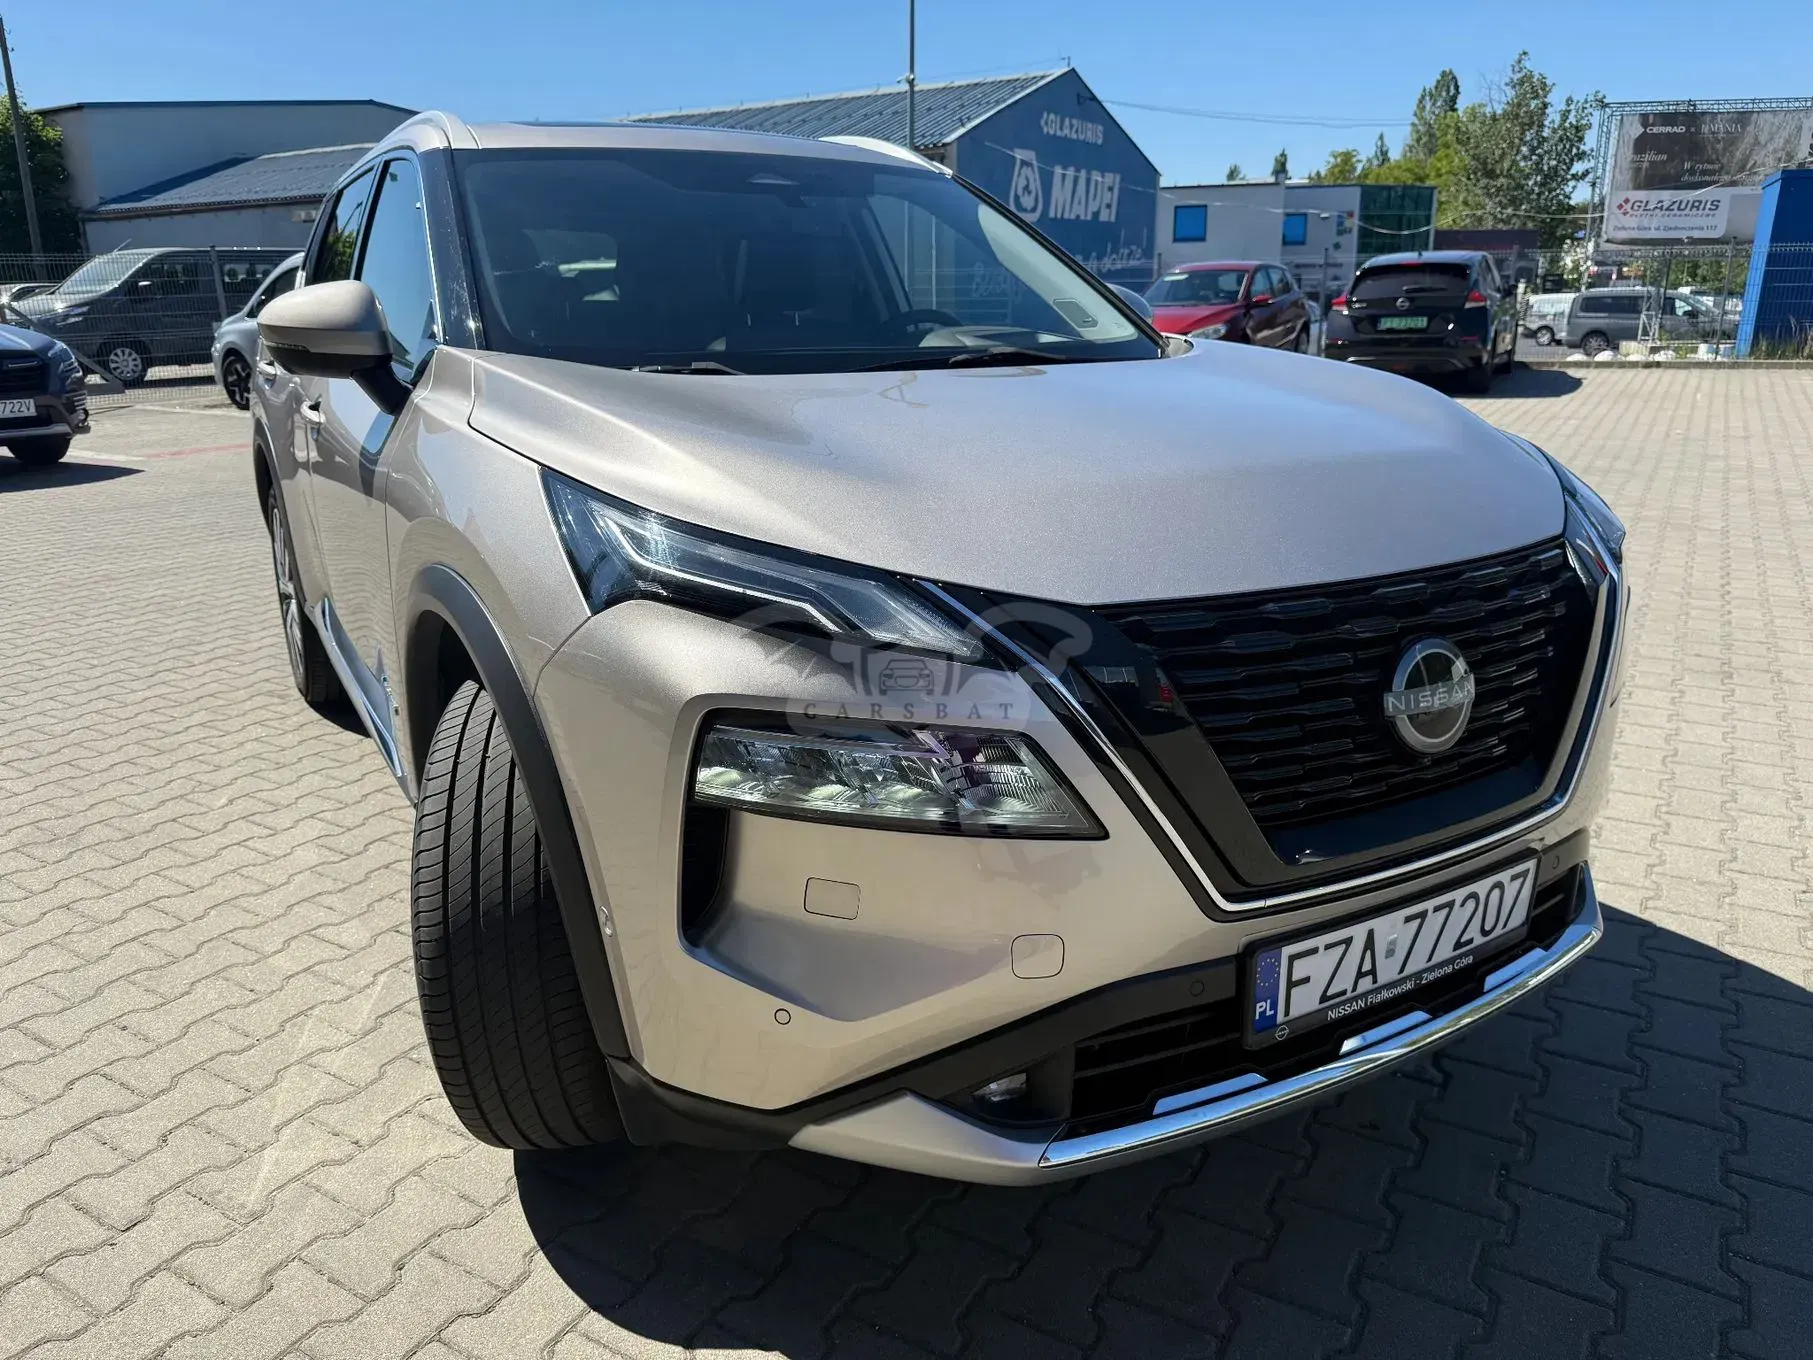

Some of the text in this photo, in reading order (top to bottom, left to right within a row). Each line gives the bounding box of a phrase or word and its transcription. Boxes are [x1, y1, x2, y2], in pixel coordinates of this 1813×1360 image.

[1048, 112, 1104, 146] GLAZURIS
[1646, 125, 1686, 134] CERRAD
[1049, 165, 1121, 223] MAPEI
[1630, 199, 1721, 212] GLAZURIS
[0, 400, 31, 415] 722V
[1387, 680, 1473, 712] NISSAN
[1283, 868, 1531, 1018] FZA 77207
[1327, 999, 1365, 1021] NISSAN
[1367, 978, 1415, 1008] Fiałkowski
[1421, 962, 1453, 985] Zielona
[1454, 955, 1474, 971] Góra
[1255, 998, 1275, 1020] PL
